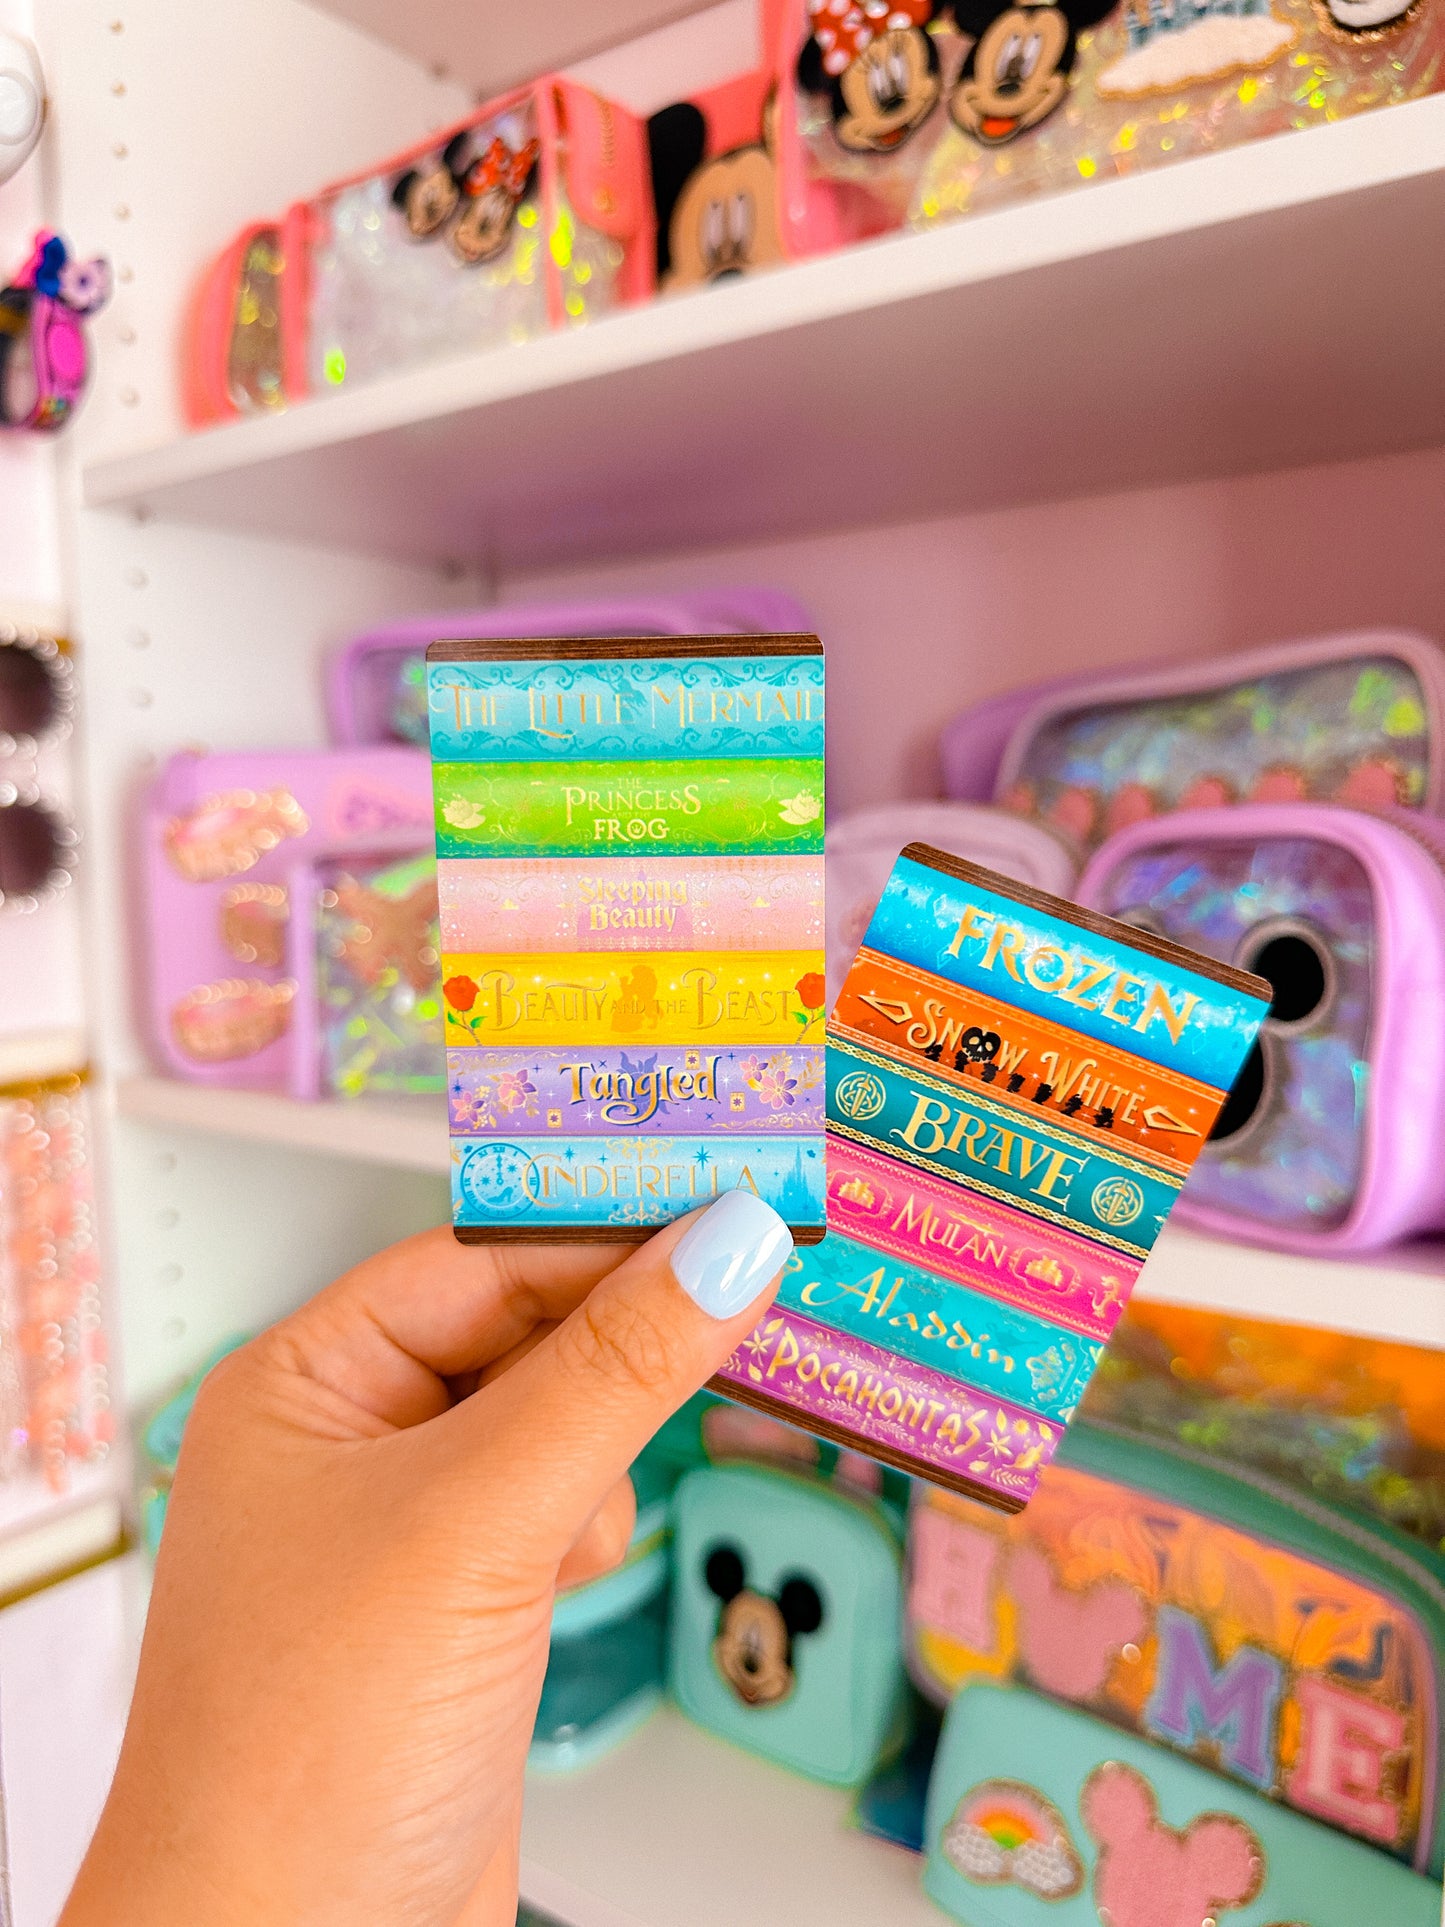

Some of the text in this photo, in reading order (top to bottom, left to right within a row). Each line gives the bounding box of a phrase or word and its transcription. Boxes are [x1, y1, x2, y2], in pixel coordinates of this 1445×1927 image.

[429, 683, 826, 739] THE LITTLE MERMAID
[560, 784, 702, 827] PRINCESS
[617, 777, 644, 790] THE
[593, 818, 670, 842] FROG
[577, 877, 688, 907] Sleeping
[589, 903, 677, 933] Beauty
[481, 968, 796, 1031] BEAUTY AND THE BEAST
[944, 904, 1202, 1046] FROZEN
[560, 1055, 723, 1125] Tangled
[906, 998, 1146, 1125] SNOW WHITE
[522, 1153, 760, 1208] CINDERELLA
[890, 1090, 1090, 1213] BRAVE
[890, 1193, 1009, 1270] MULAN
[801, 1266, 1017, 1374] Aladdin
[765, 1326, 990, 1456] POCAHONTAS
